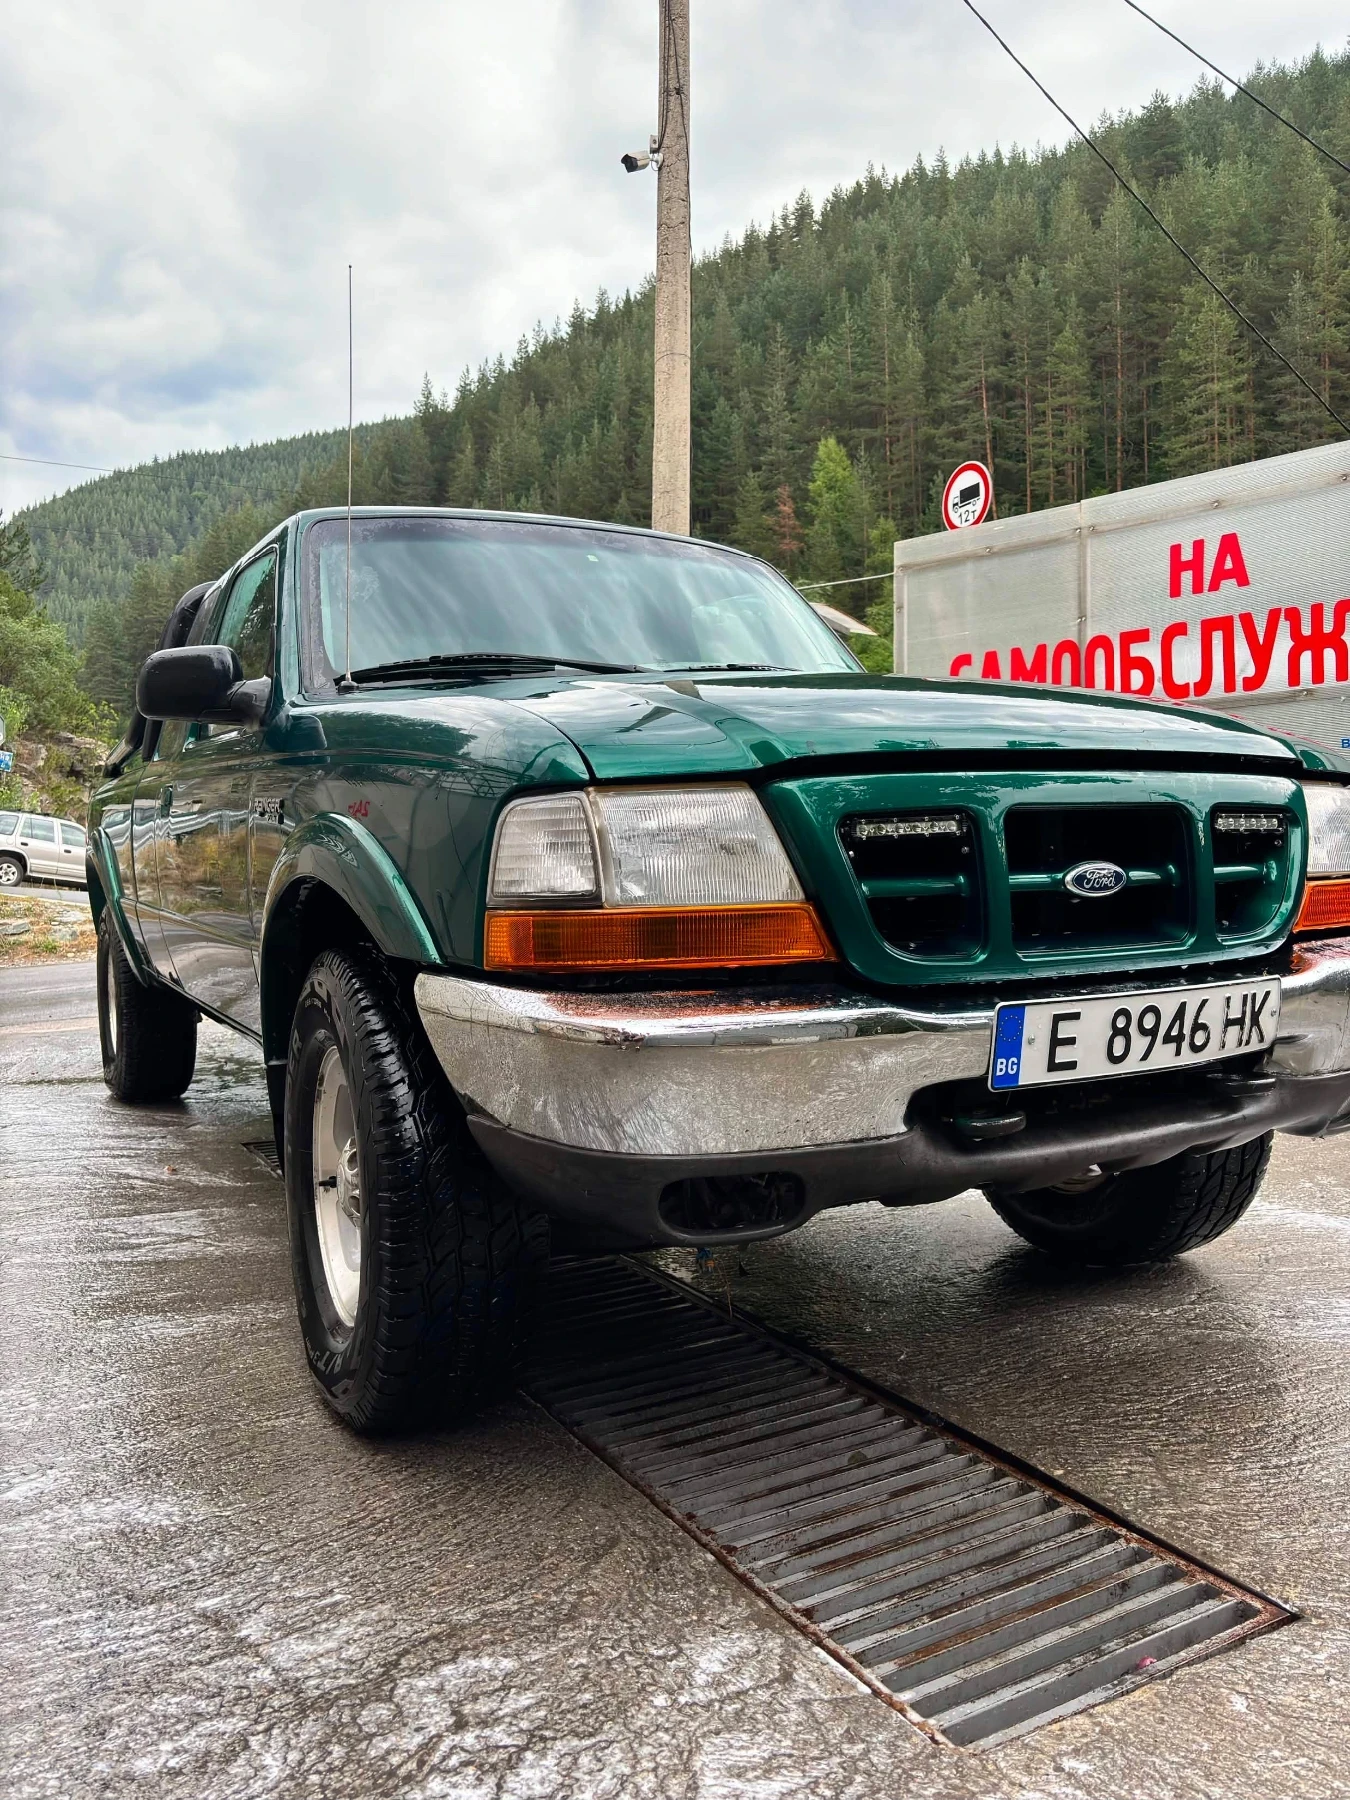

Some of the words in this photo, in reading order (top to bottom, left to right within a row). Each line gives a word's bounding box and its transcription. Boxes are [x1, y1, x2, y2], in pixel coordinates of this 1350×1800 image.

[1169, 532, 1251, 598] НА
[1083, 869, 1116, 889] Ford
[1047, 1011, 1082, 1073] E
[1106, 997, 1211, 1065] 8946
[1219, 989, 1272, 1051] HK
[996, 1056, 1018, 1077] BG
